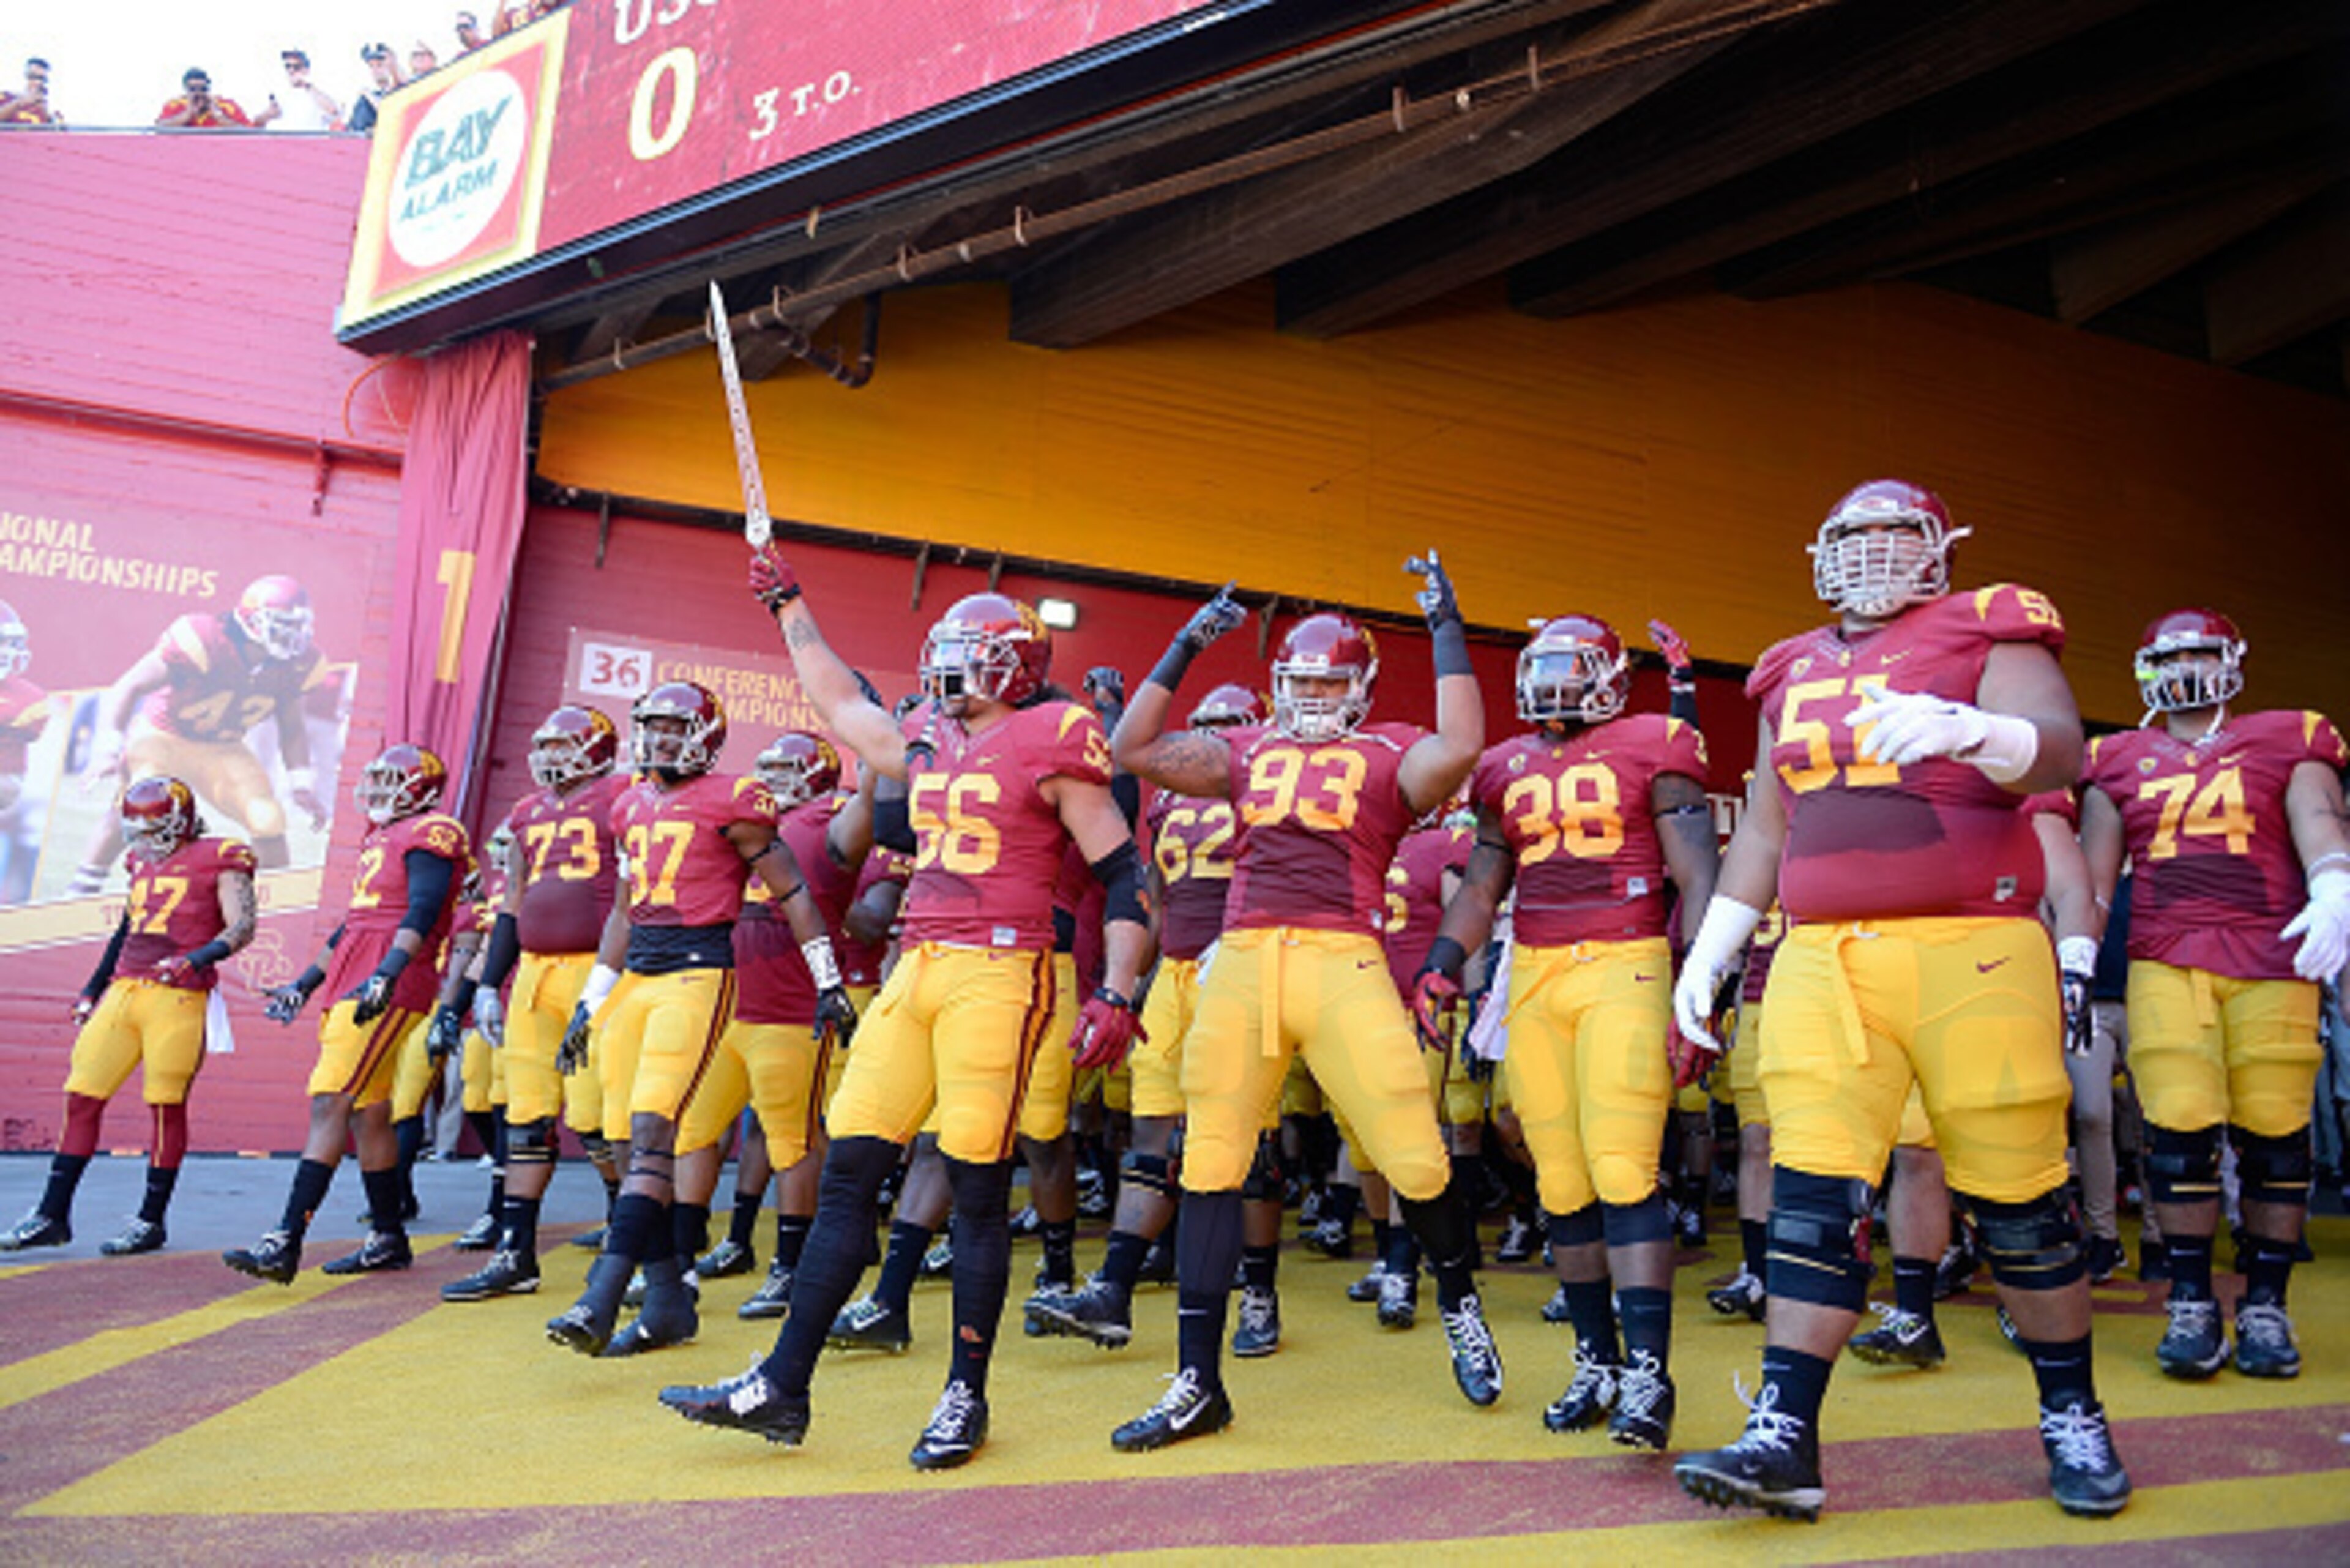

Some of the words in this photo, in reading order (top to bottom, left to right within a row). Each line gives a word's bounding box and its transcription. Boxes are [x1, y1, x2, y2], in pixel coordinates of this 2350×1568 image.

[405, 93, 513, 190] BAY
[629, 47, 698, 160] 0
[748, 87, 780, 140] 3
[790, 71, 861, 116] T.O.
[399, 158, 499, 223] ALARM
[435, 550, 476, 684] 1
[591, 652, 640, 687] 36
[1775, 673, 1901, 794] 51
[909, 773, 1001, 874] 56
[1241, 747, 1367, 831] 93
[1504, 762, 1624, 866] 38
[2138, 766, 2256, 861] 74
[349, 846, 384, 908] 2
[526, 818, 600, 886] 73
[1155, 803, 1234, 885] 62
[130, 877, 189, 934] 47
